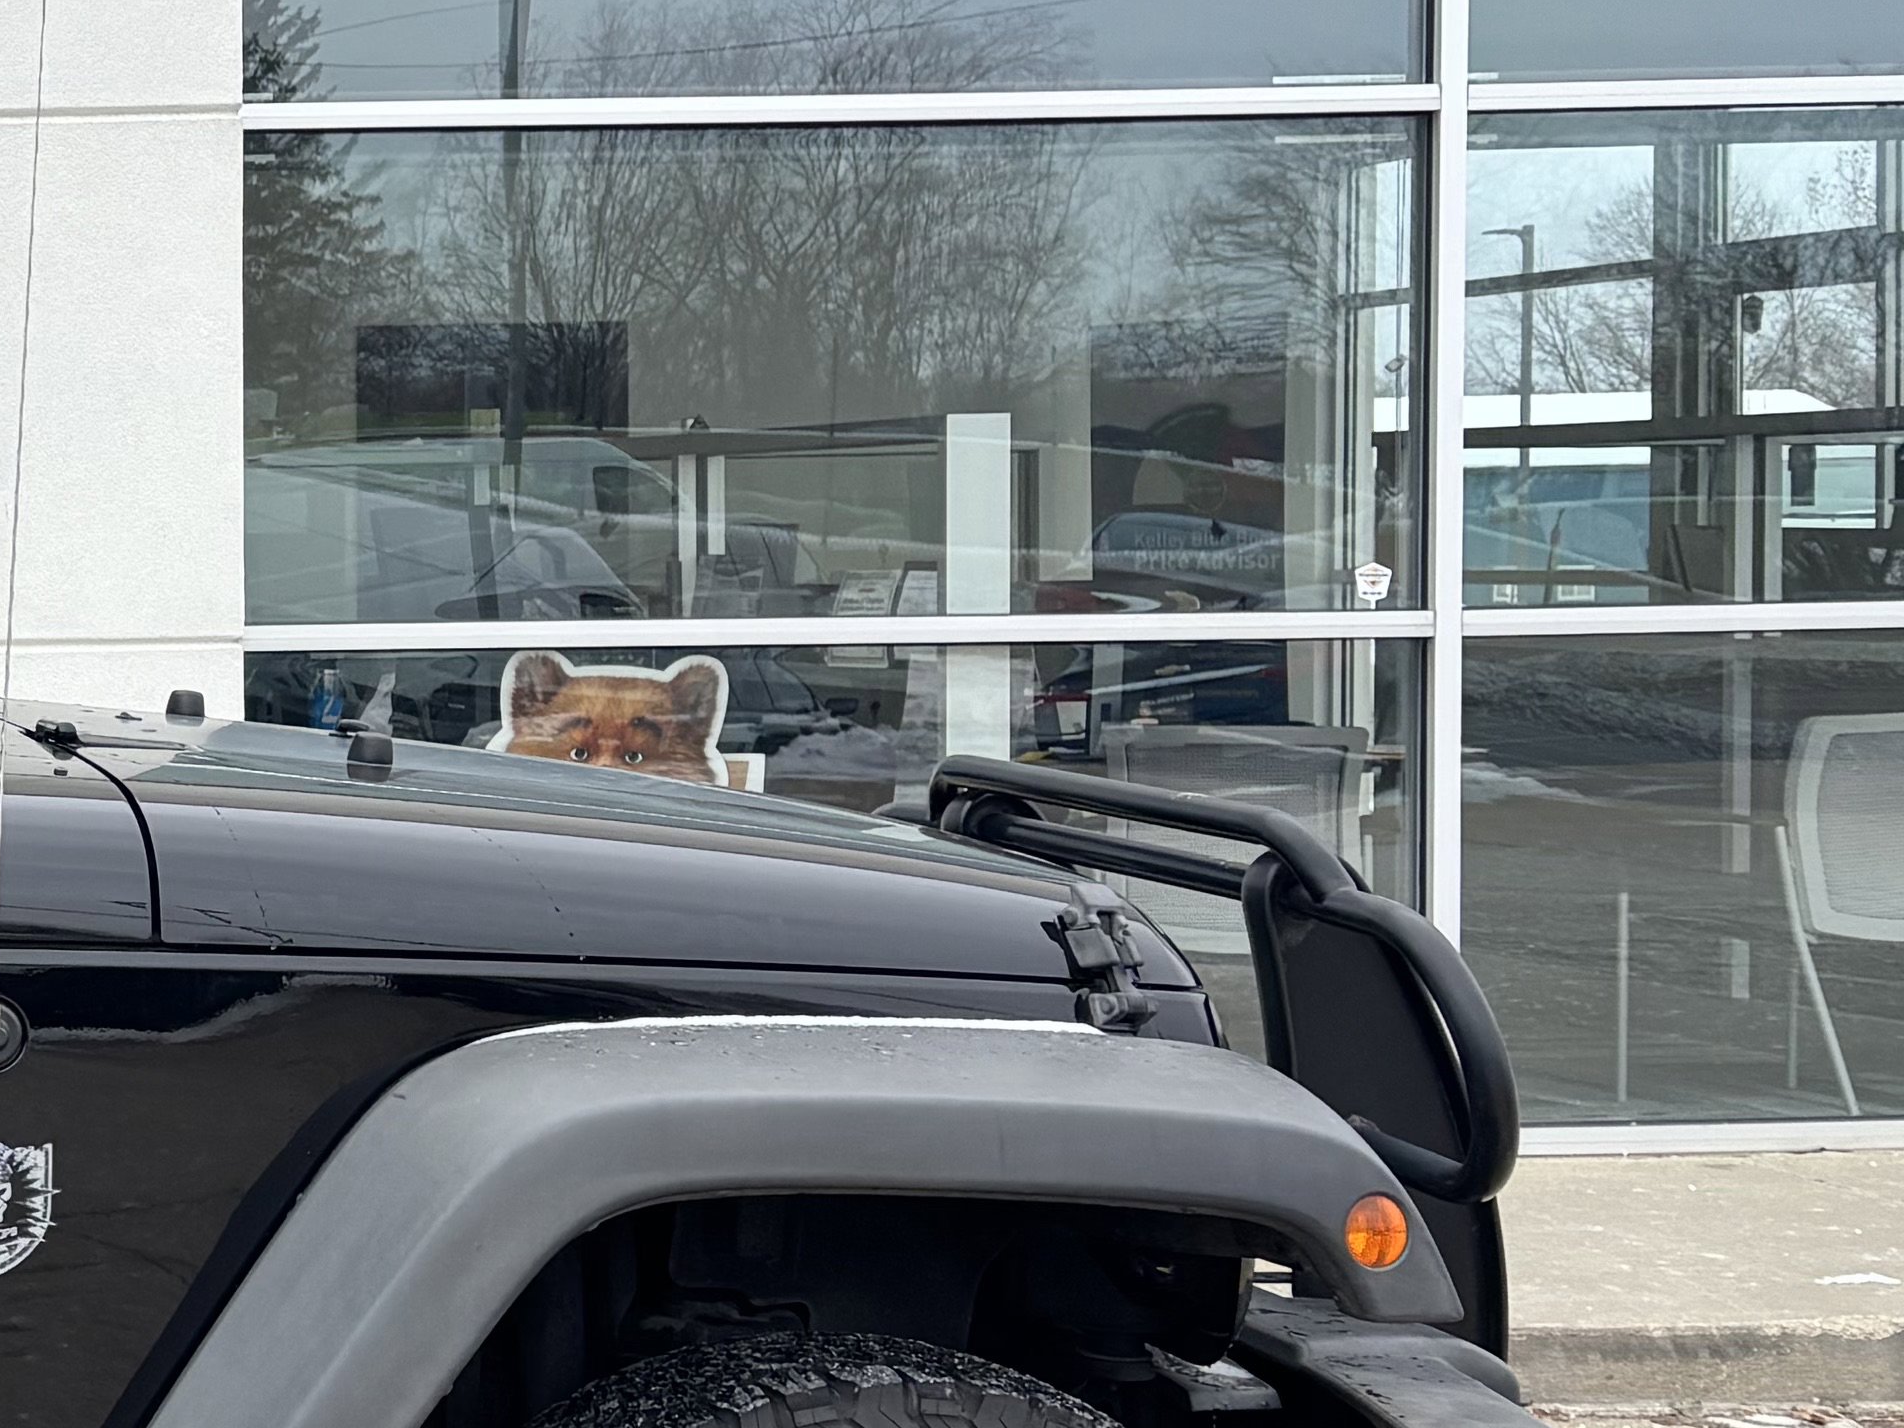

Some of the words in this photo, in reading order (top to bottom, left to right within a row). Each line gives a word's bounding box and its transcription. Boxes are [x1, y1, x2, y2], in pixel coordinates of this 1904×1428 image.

[1135, 530, 1186, 550] Kelley
[1135, 550, 1189, 571] Price
[1196, 551, 1280, 571] Advisor
